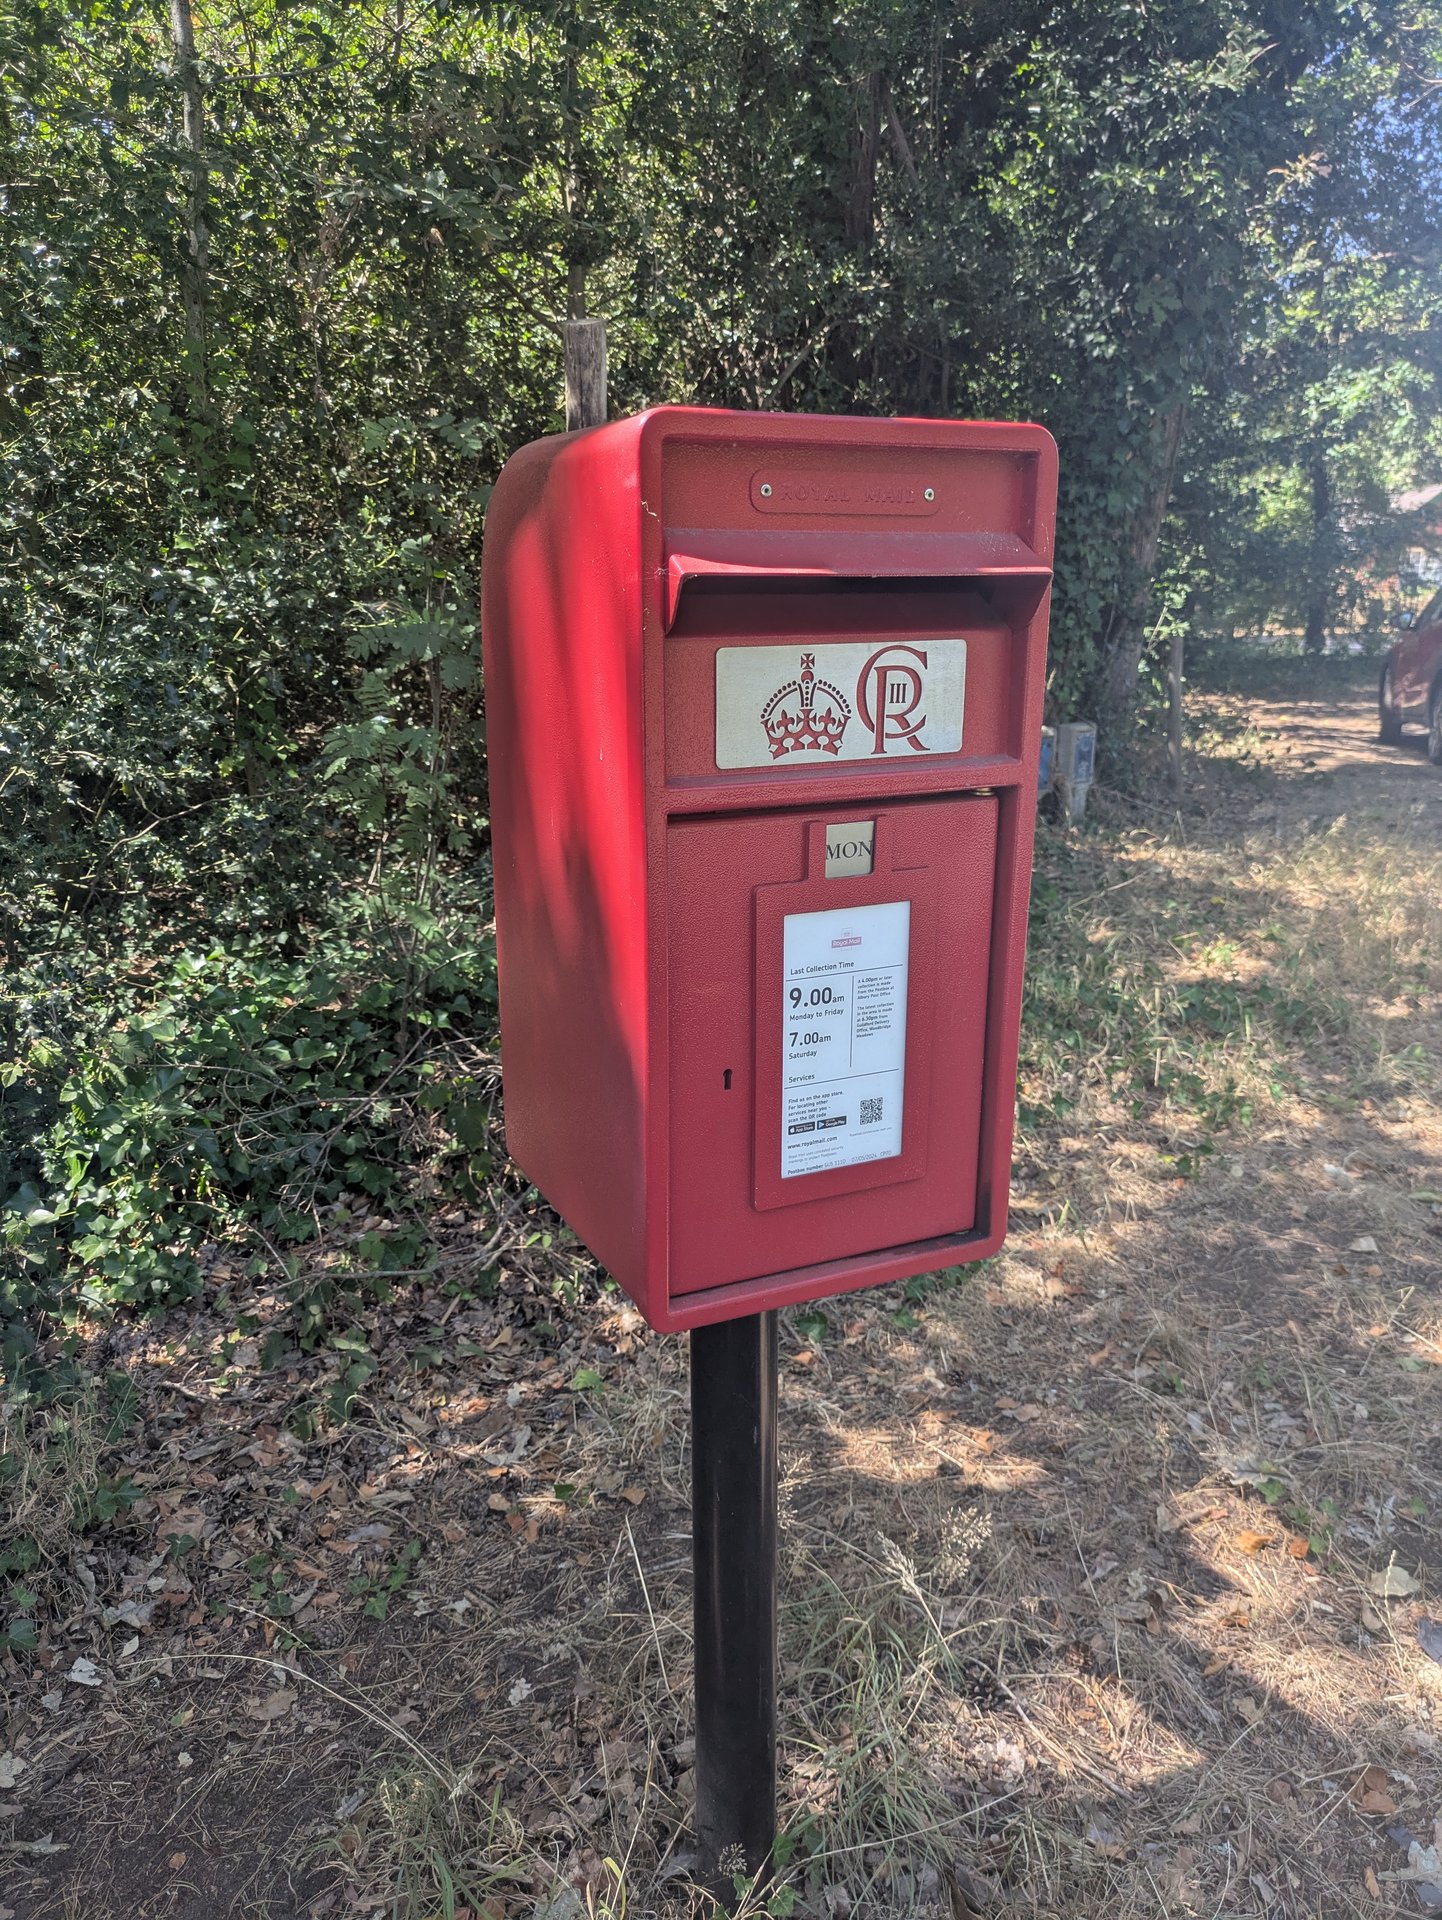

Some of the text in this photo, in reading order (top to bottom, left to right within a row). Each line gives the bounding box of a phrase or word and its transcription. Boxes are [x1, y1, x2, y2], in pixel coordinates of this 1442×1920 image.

[780, 483, 915, 504] ROYAL MAIL
[826, 840, 872, 860] MON
[806, 963, 837, 973] Collection
[839, 961, 854, 969] Time
[789, 987, 845, 1009] 9.00am
[790, 1012, 814, 1021] Monday
[789, 1032, 831, 1047] 7.00am
[789, 1050, 817, 1060] Saturday
[788, 1074, 815, 1084] Services
[796, 1101, 815, 1109] locating
[788, 1109, 807, 1117] services
[787, 1136, 837, 1150] www.royalmail.com
[788, 1167, 805, 1175] Postbox
[806, 1163, 823, 1171] number
